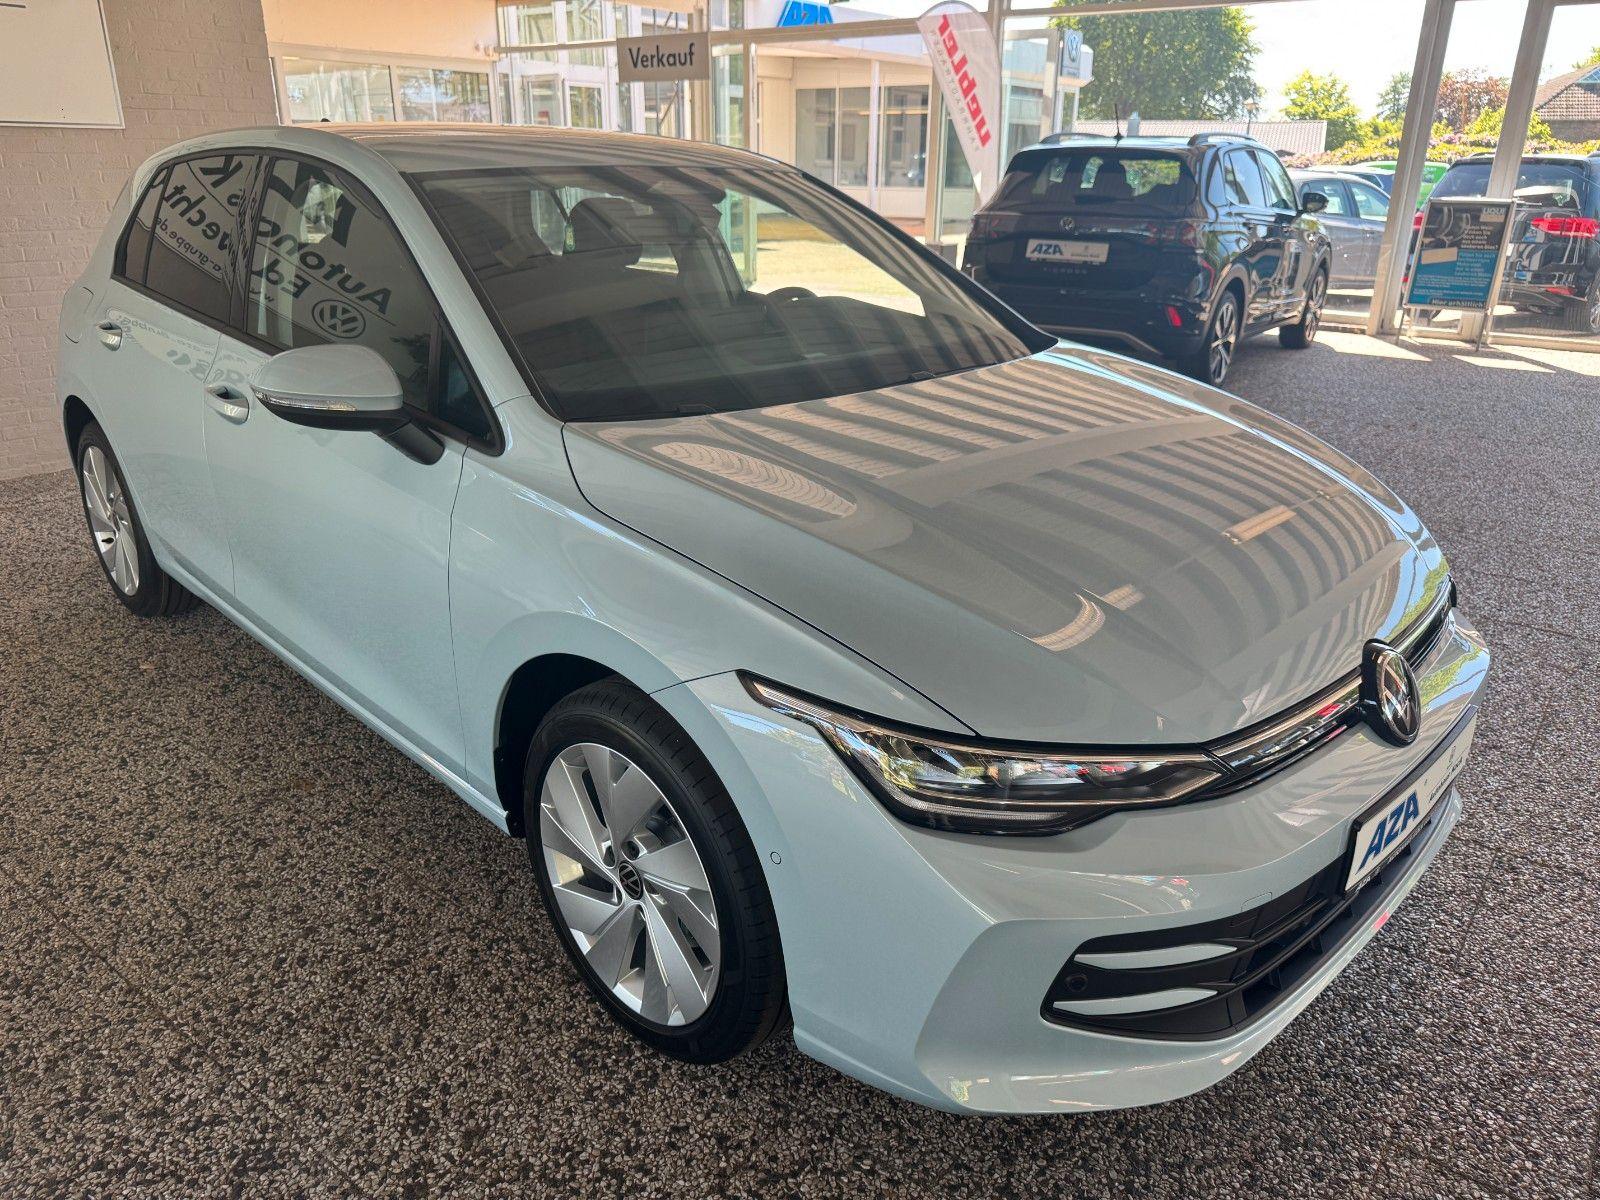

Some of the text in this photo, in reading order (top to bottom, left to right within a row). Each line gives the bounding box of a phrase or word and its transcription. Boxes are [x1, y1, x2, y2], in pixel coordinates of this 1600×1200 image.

[629, 42, 695, 69] Verkauf
[1030, 243, 1064, 256] AZA
[1355, 789, 1419, 875] AZA
